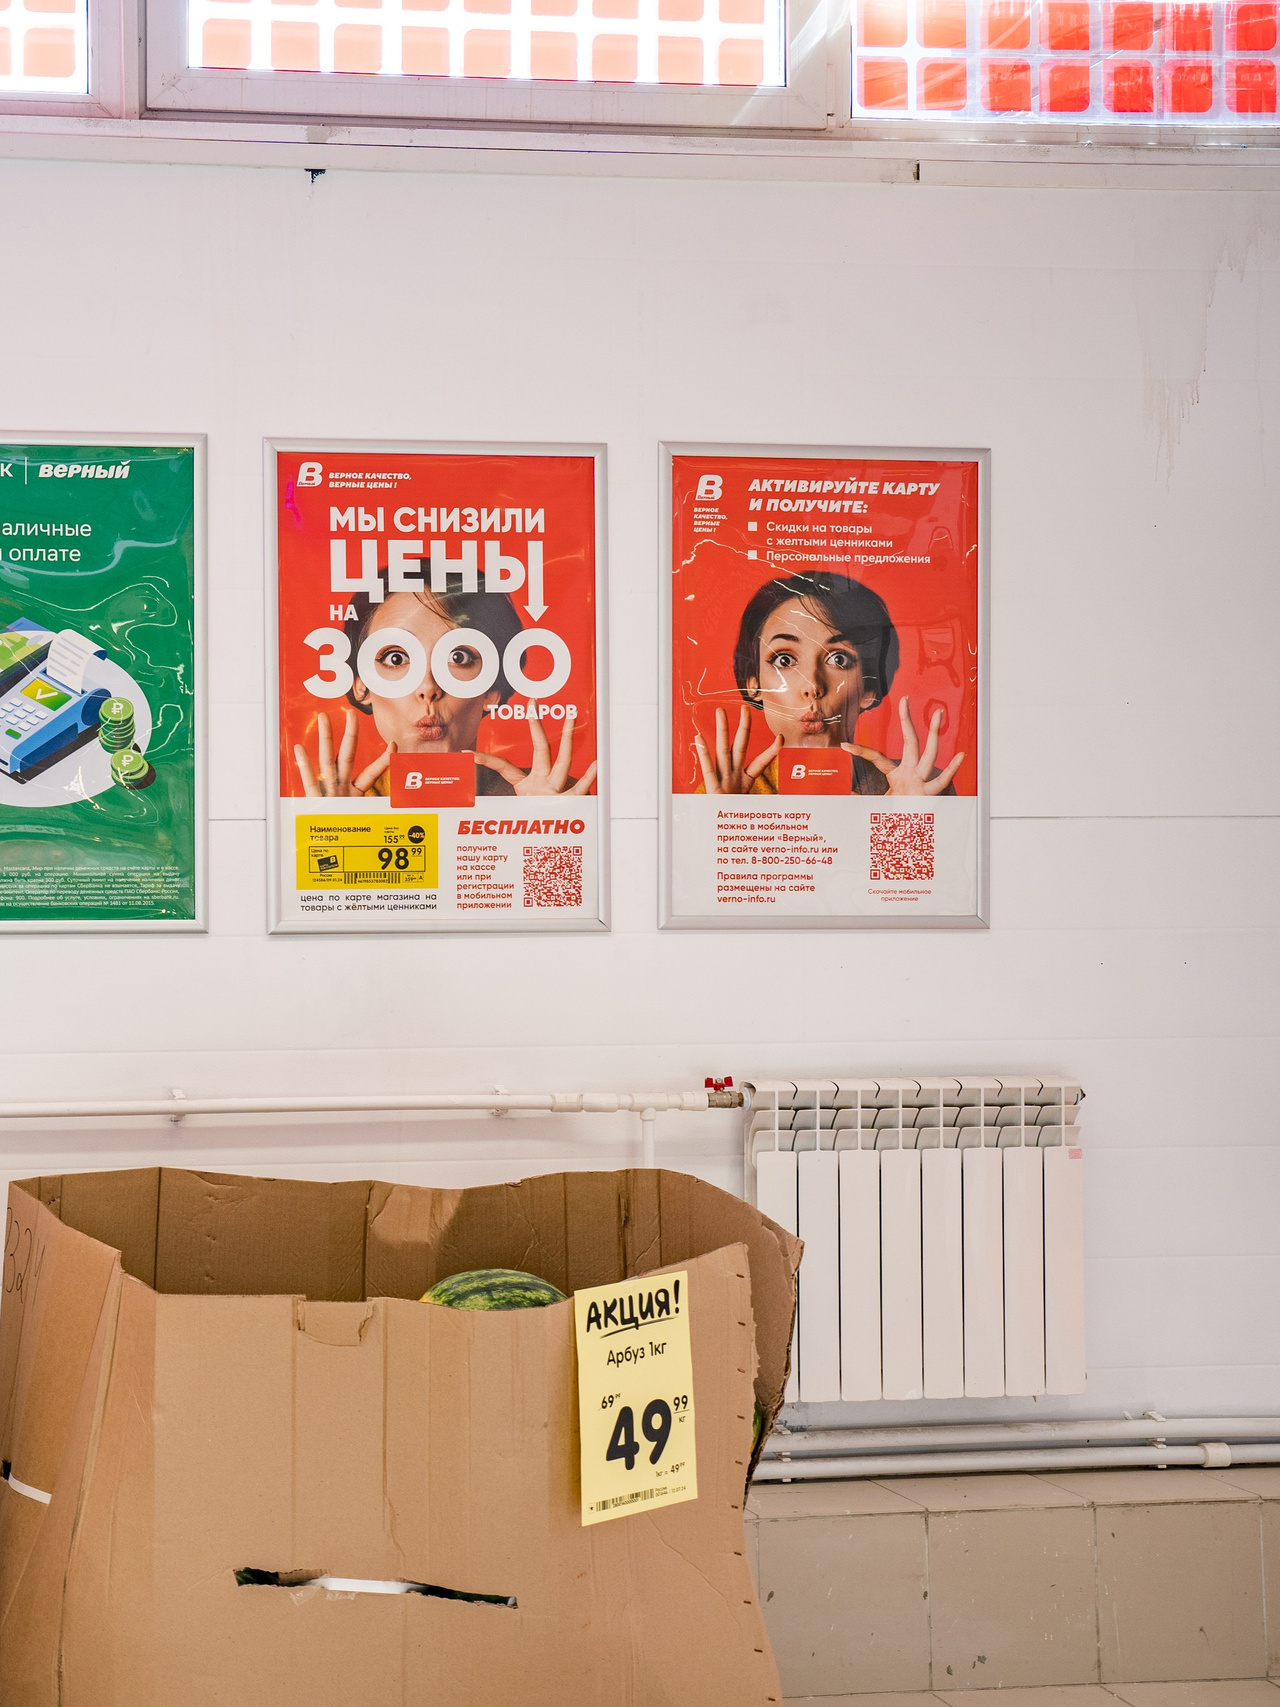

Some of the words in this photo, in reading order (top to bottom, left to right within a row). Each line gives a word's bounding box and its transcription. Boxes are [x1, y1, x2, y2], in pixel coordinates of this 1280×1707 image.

[364, 472, 412, 481] КАЧЕСТВО,
[366, 481, 393, 490] ЦЕНЫ
[748, 477, 879, 495] АКТИВИРУЙТЕ
[882, 482, 940, 496] КАРТУ
[749, 498, 763, 512] И
[766, 499, 869, 514] ПОЛУЧИТЕ:
[329, 506, 384, 532] МЫ
[393, 507, 545, 533] СНИЗИЛИ
[766, 521, 809, 534] Скидки
[812, 523, 828, 533] на
[829, 523, 872, 536] товары
[775, 536, 828, 547] желтыми
[829, 537, 893, 549] ценниками
[8, 548, 82, 562] оплате
[766, 551, 852, 564] Персональные
[854, 552, 931, 565] предложения
[330, 539, 550, 623] ЦЕНЫ
[329, 604, 359, 621] НА
[302, 627, 572, 699] 3000
[487, 704, 578, 720] ТОВАРОВ
[717, 810, 782, 820] Активировать
[784, 811, 811, 821] карту
[457, 819, 586, 836] БЕСПЛАТНО
[717, 823, 748, 831] можно
[757, 822, 809, 831] мобильном
[310, 834, 339, 843] товара
[383, 835, 399, 844] 155
[717, 834, 775, 843] приложении
[777, 832, 827, 844] «Верный»,
[456, 844, 498, 852] получите
[717, 845, 729, 854] на
[731, 845, 759, 854] сайте
[760, 845, 820, 854] verno-info.ru
[822, 846, 839, 854] или
[378, 847, 409, 870] 98
[456, 854, 480, 864] нашу
[482, 854, 508, 864] карту
[717, 857, 729, 865] по
[730, 857, 749, 865] тел.
[751, 855, 833, 866] 8-800-250-66-48
[471, 863, 496, 872] кассе
[474, 873, 492, 882] при
[717, 871, 758, 881] Правила
[760, 872, 814, 883] программы
[456, 882, 515, 892] регистрации
[717, 884, 772, 894] размещены
[774, 884, 786, 892] на
[788, 884, 816, 893] сайте
[867, 888, 897, 896] Скачайте
[898, 888, 932, 896] мобильное
[300, 894, 322, 903] цена
[328, 894, 341, 903] по
[345, 894, 372, 903] карте
[377, 893, 420, 901] магазина
[425, 893, 437, 901] на
[463, 891, 513, 900] мобильном
[717, 894, 776, 904] verno-info.ru
[300, 903, 335, 913] товары
[344, 902, 385, 912] жёлтыми
[387, 903, 437, 912] ценниками
[456, 901, 512, 910] приложении
[586, 1279, 680, 1333] АКЦИЯ!
[606, 1347, 645, 1368] Арбуз
[649, 1341, 667, 1357] 1кг
[601, 1394, 614, 1410] 69
[605, 1398, 672, 1470] 49
[673, 1394, 688, 1411] 99
